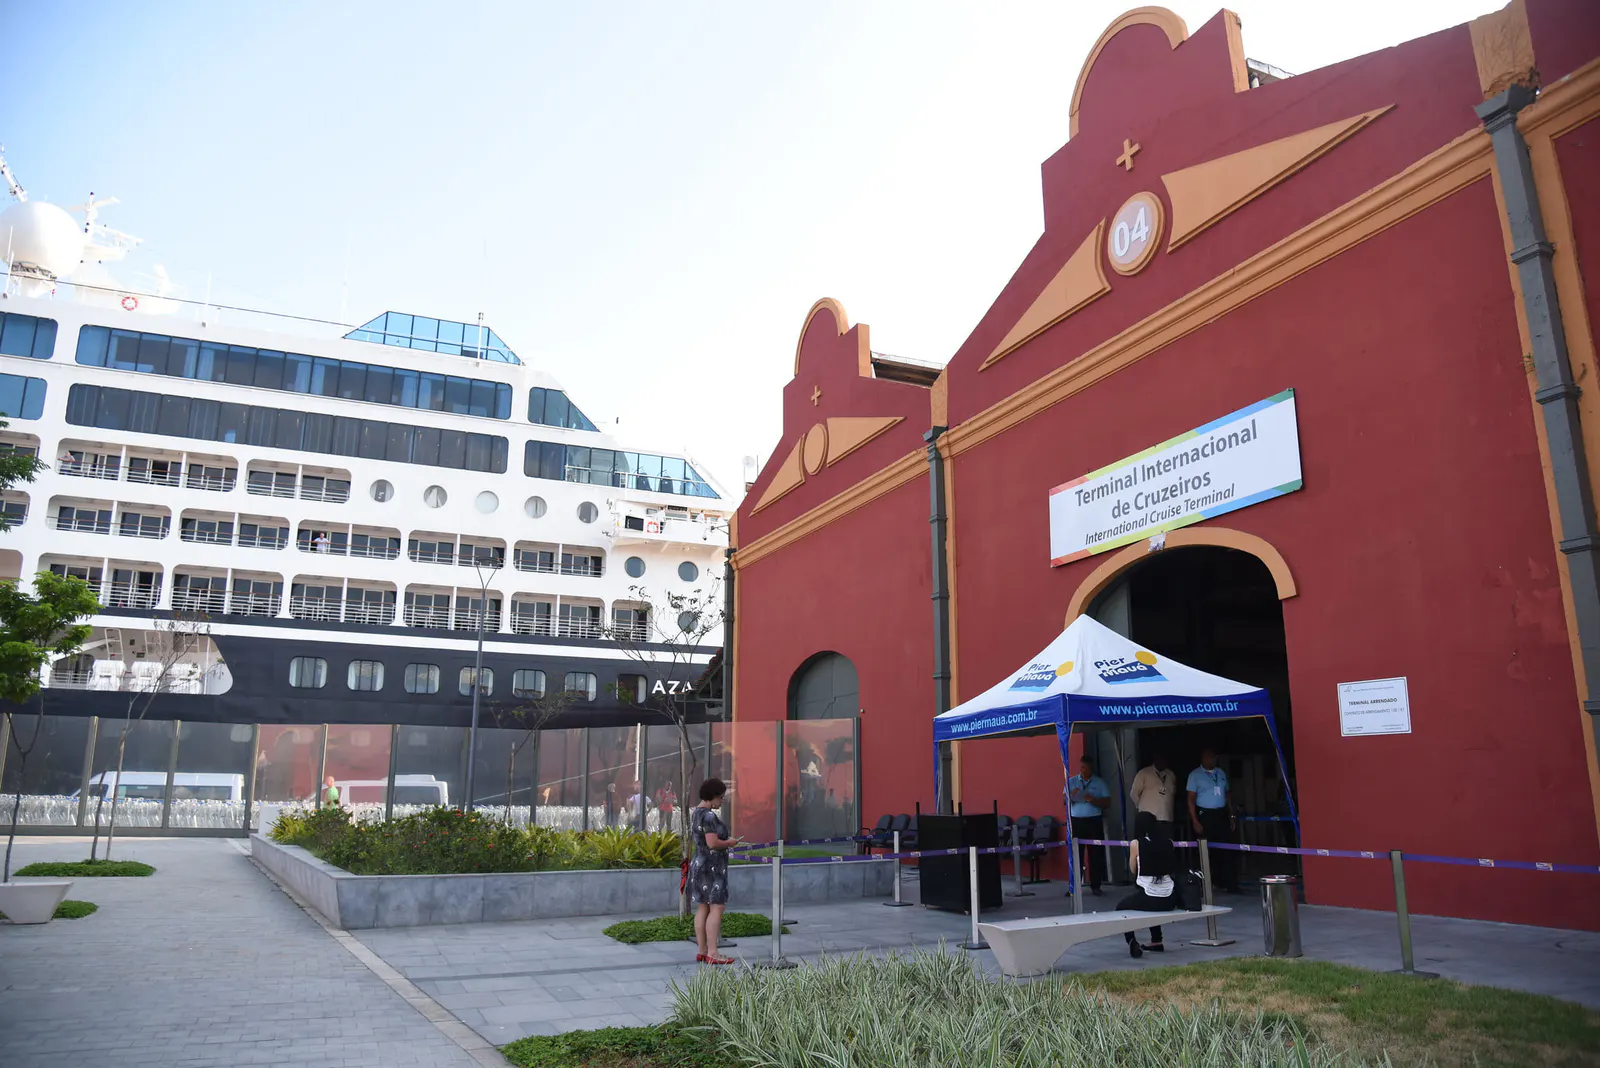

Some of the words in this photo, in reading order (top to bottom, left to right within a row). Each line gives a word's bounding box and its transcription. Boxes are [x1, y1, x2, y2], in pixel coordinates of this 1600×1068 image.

[1114, 206, 1149, 257] 04
[1075, 467, 1138, 506] Terminal
[1141, 419, 1258, 483] Internacional
[1111, 497, 1130, 519] de
[1134, 470, 1212, 511] Cruzeiros
[1085, 513, 1148, 546] International
[1149, 505, 1182, 524] Cruise
[1184, 483, 1235, 511] Terminal
[1028, 663, 1051, 671] Pier
[1094, 657, 1125, 669] Pier
[1101, 662, 1148, 677] Mauá
[950, 708, 1039, 734] www.piermaua.com.br
[1099, 700, 1239, 717] www.piermaua.com.br
